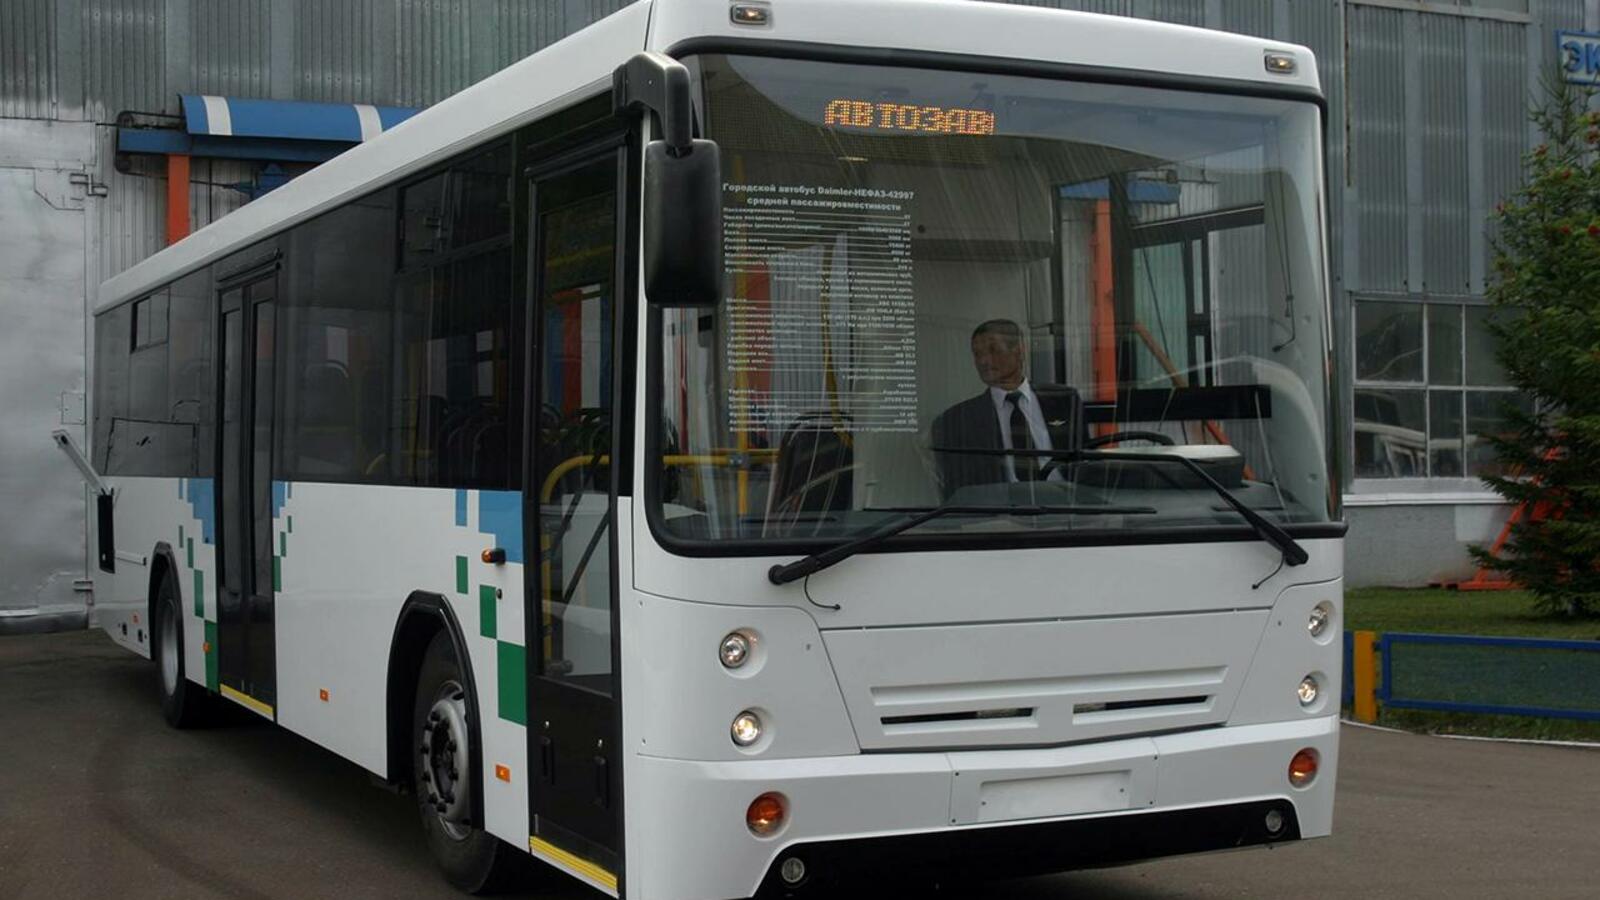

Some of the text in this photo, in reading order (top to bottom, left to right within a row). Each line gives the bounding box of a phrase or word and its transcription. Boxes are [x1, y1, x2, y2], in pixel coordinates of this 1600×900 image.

[723, 182, 776, 193] Городской
[778, 185, 816, 196] автобус
[747, 197, 901, 211] средней пассажировместимости
